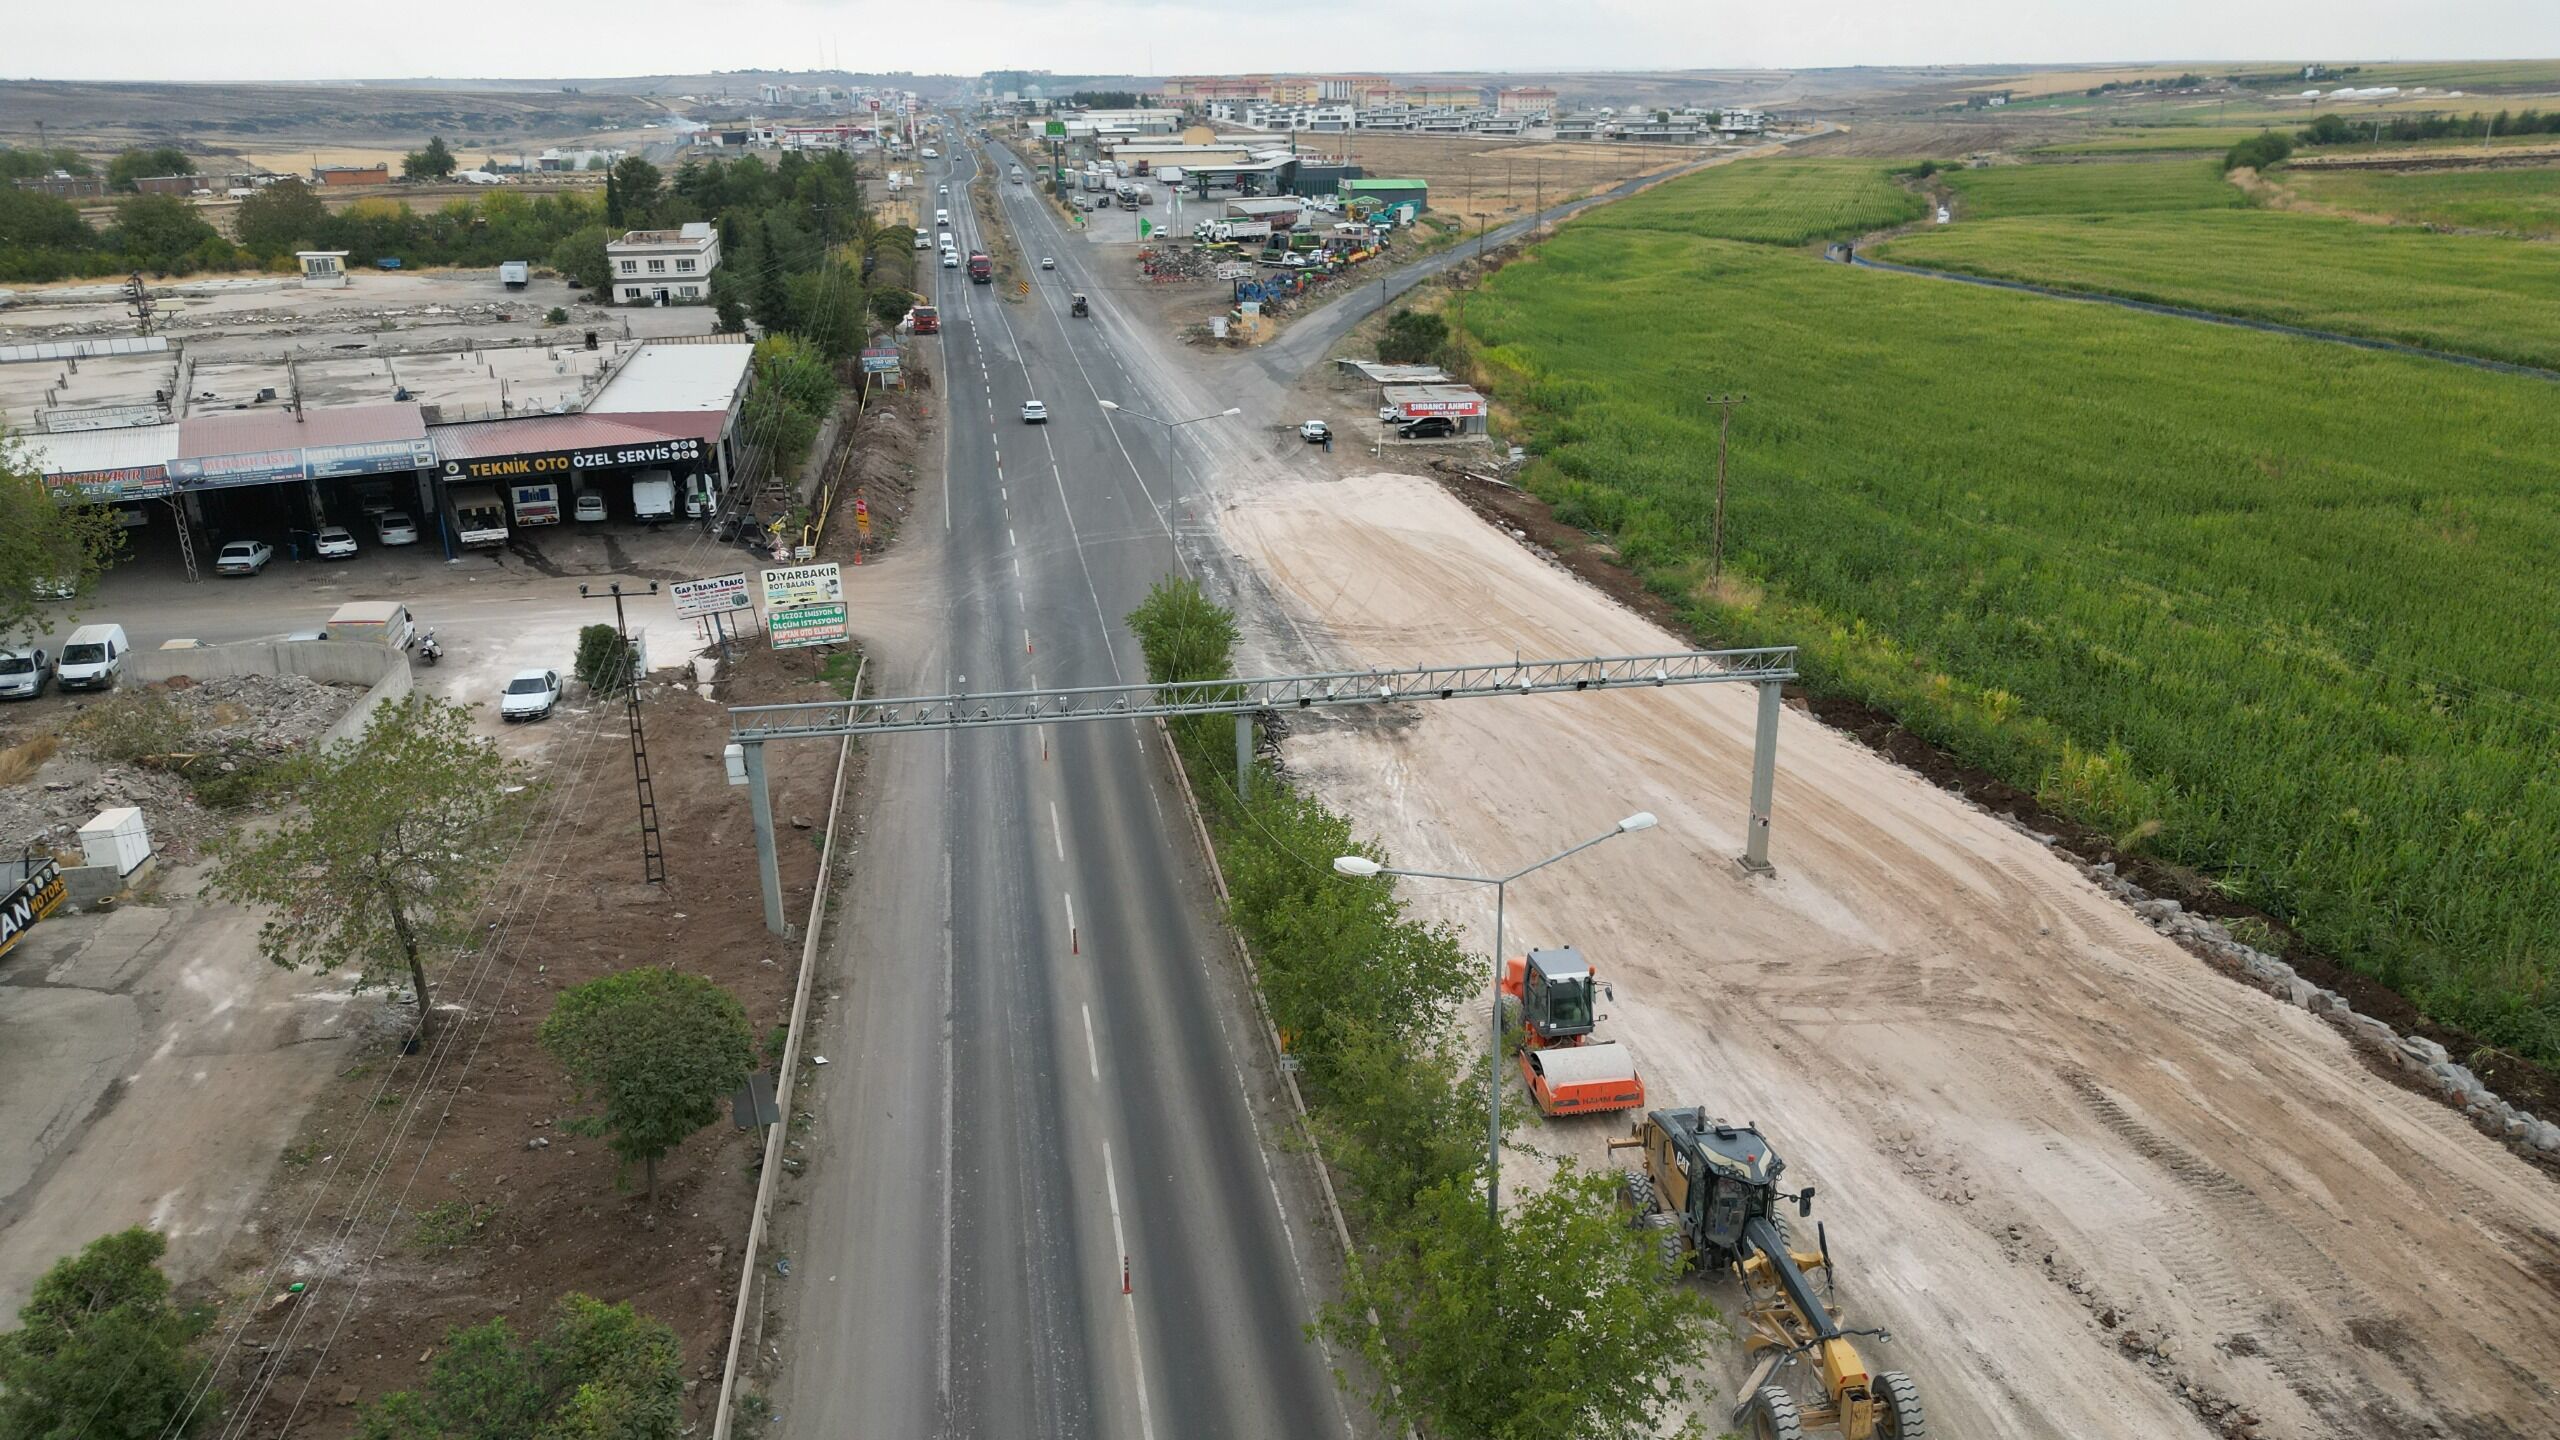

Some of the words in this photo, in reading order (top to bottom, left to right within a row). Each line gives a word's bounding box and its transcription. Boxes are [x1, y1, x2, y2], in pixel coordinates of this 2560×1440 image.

[1447, 402, 1472, 410] AHMET
[345, 447, 365, 458] OTO
[469, 457, 531, 477] TEKNİK
[534, 457, 569, 471] OTO
[573, 452, 613, 468] ÖZEL
[617, 444, 670, 463] SERVİS
[674, 586, 691, 595] GAP
[692, 582, 718, 591] TRANS
[769, 580, 815, 590] ROT-BALANS
[772, 620, 800, 630] ÖLÇÜM
[801, 617, 843, 627] İSTASYONU
[800, 628, 812, 636] OTO
[0, 896, 31, 945] AN
[30, 875, 65, 914] MOTORS
[1676, 1151, 1690, 1176] CAT
